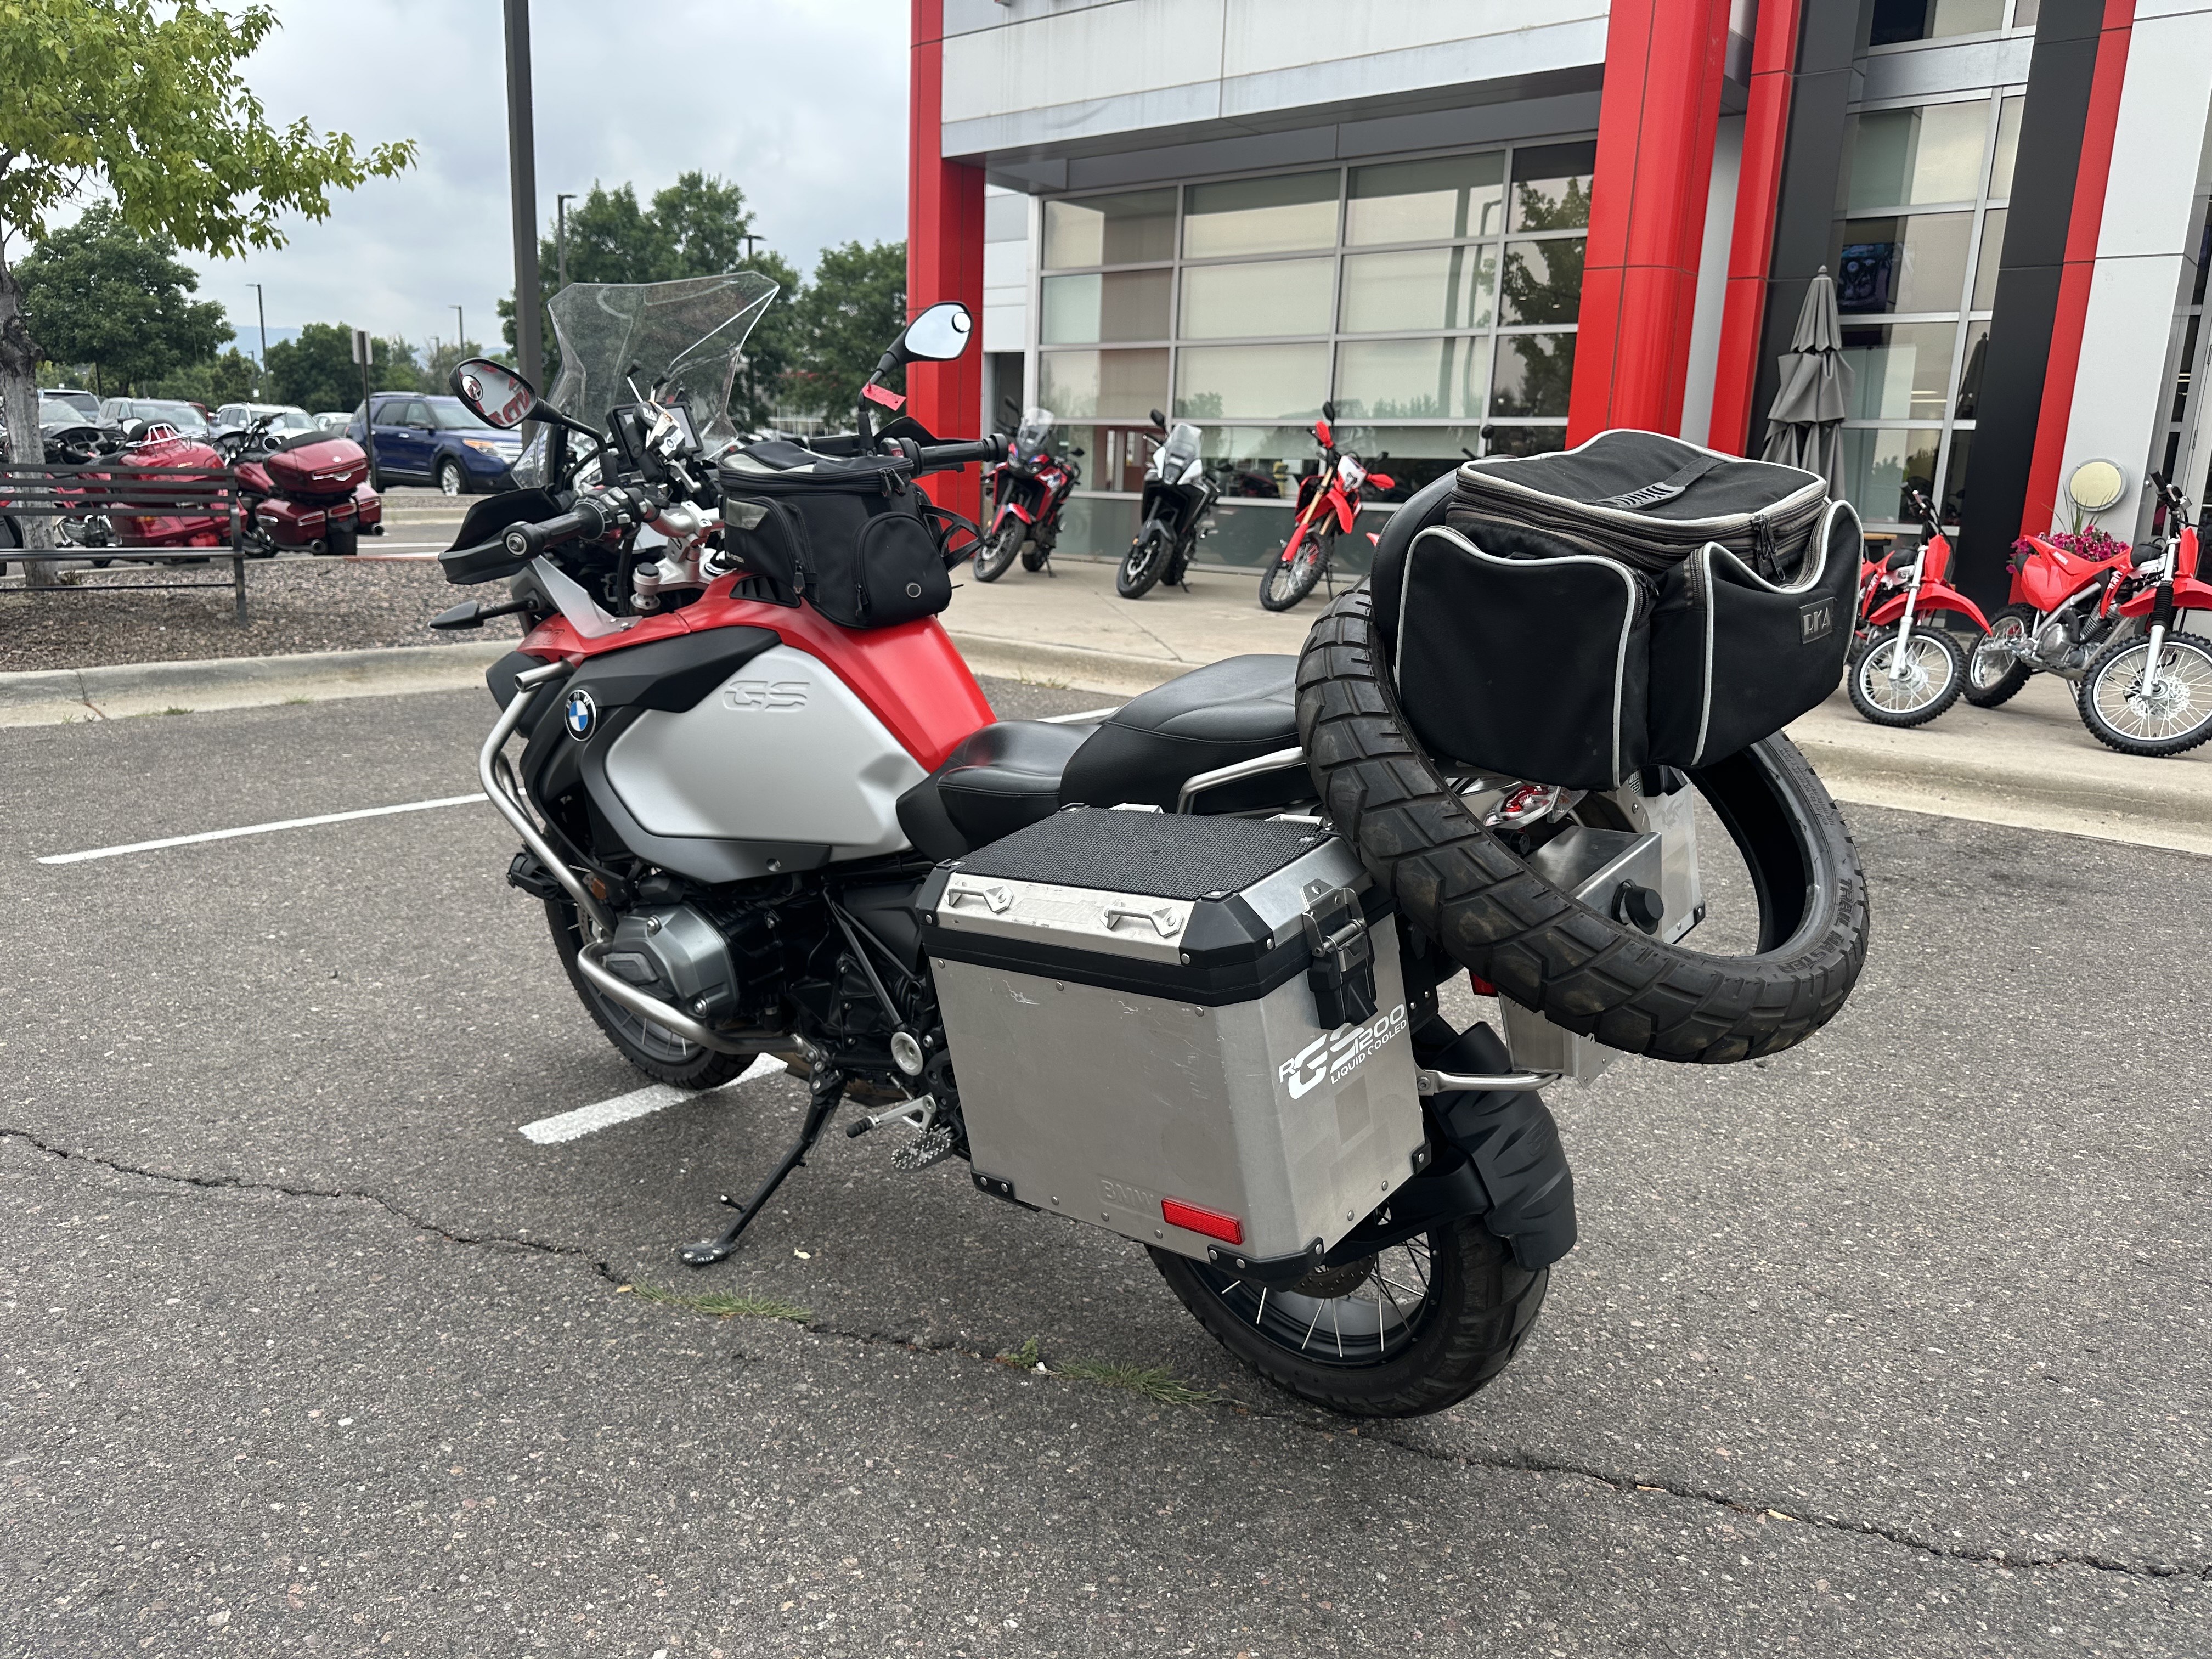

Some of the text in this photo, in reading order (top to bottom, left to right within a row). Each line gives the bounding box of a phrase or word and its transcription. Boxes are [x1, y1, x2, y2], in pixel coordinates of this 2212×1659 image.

[723, 680, 810, 713] GS
[1775, 878, 1854, 974] TRAIL MASTER
[1330, 1019, 1407, 1085] LIQUID COOLED
[1100, 1179, 1154, 1214] BMW
